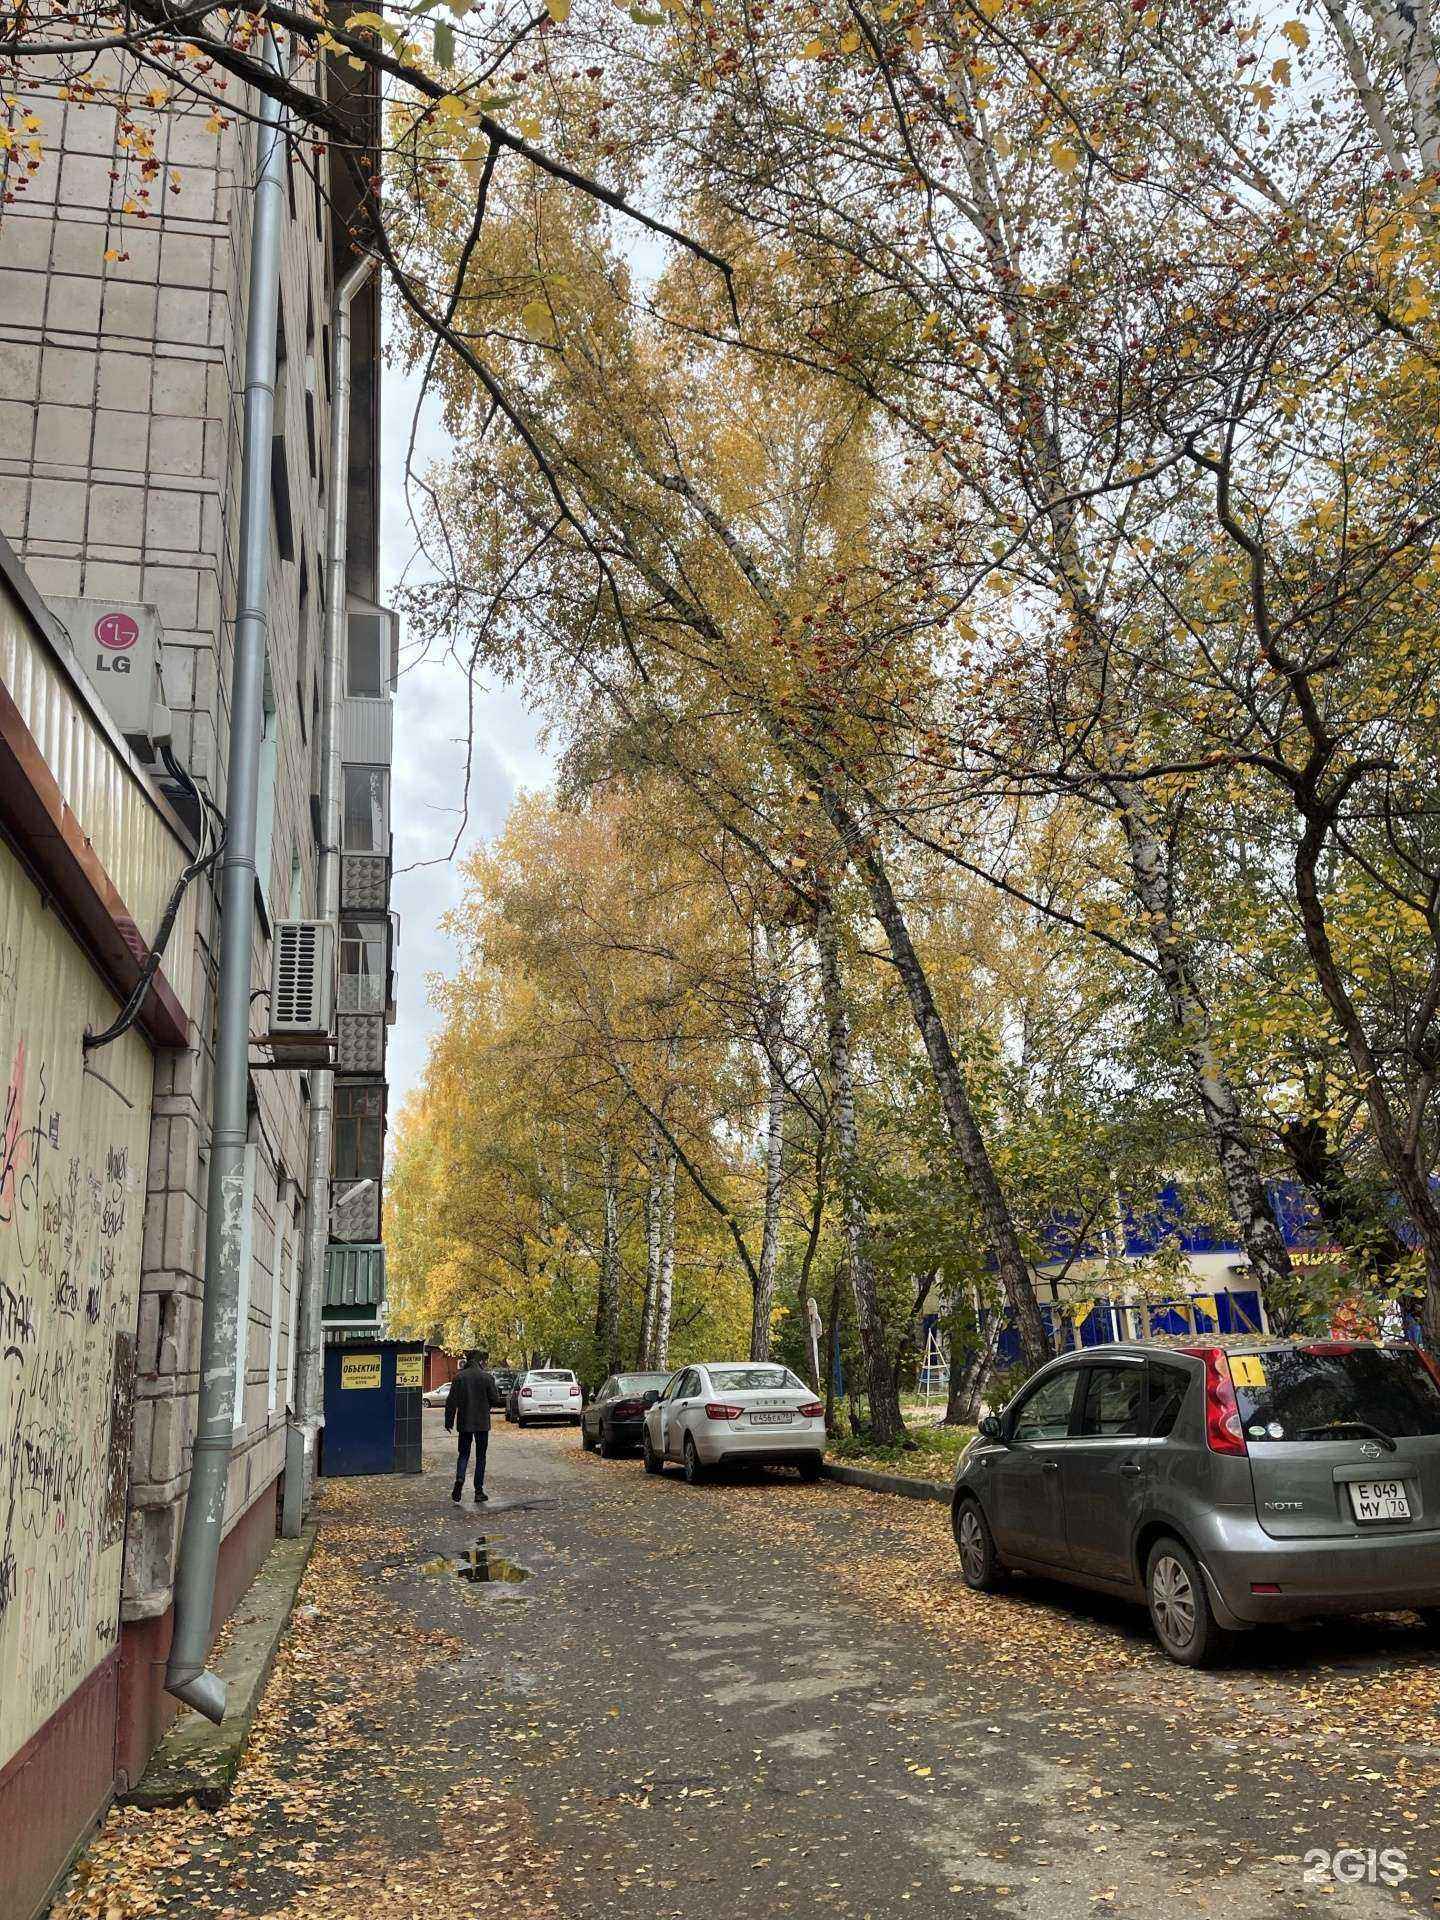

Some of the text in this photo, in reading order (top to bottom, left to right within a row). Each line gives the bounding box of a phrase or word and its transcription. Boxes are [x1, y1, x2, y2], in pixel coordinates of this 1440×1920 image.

[96, 654, 131, 674] LG
[343, 1363, 380, 1374] ОБЪЕКТИВ
[399, 1375, 419, 1383] 16-22
[1373, 1483, 1398, 1499] 049
[1264, 1502, 1304, 1511] NOTE
[1390, 1500, 1405, 1513] 70
